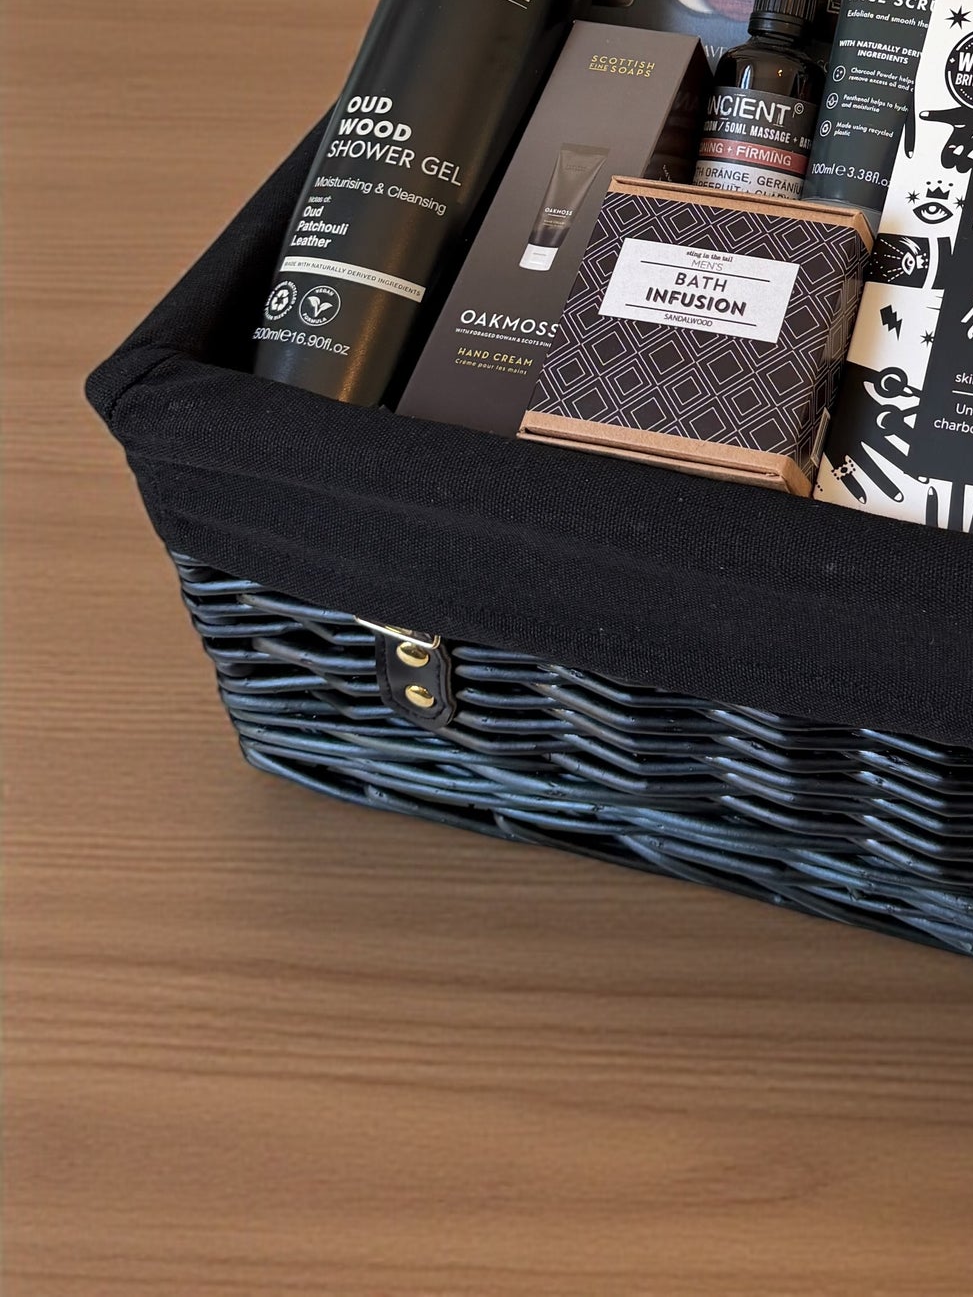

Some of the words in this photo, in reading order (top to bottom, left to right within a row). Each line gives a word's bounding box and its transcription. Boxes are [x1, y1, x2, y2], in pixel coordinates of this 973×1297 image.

[847, 10, 874, 19] Exfoliate
[875, 13, 890, 21] and
[890, 16, 917, 26] smooth
[856, 40, 900, 53] NATURALLY
[591, 55, 655, 70] SCOTTISH
[857, 49, 909, 65] INGREDIENTS
[589, 63, 609, 71] FINE
[610, 65, 651, 77] SOAPS
[851, 67, 876, 76] Charcoal
[876, 71, 898, 80] Powder
[899, 76, 914, 85] helps
[869, 78, 888, 86] excess
[346, 96, 393, 114] OUD
[843, 94, 870, 103] Panthenol
[870, 97, 886, 107] helps
[852, 104, 880, 113] moisturise
[338, 118, 412, 142] WOOD
[725, 122, 747, 135] 50ML
[750, 126, 791, 144] MASSAGE
[852, 124, 868, 133] using
[868, 127, 894, 138] recycled
[327, 140, 415, 169] SHOWER
[421, 157, 462, 187] GEL
[735, 145, 792, 166] FIRMING
[705, 167, 752, 185] ORANGE,
[811, 164, 835, 175] 100ml
[315, 176, 373, 194] Moisturising
[375, 183, 384, 194] &
[387, 186, 447, 216] Cleansing
[303, 206, 324, 217] Oud
[544, 207, 573, 216] OAKMOSS
[297, 220, 349, 236] Patchouli
[290, 235, 332, 248] Leather
[691, 259, 724, 271] MEN'S
[311, 263, 346, 274] NATURALLY
[346, 269, 377, 281] DERIVED
[377, 278, 421, 297] INGREDIENTS
[675, 272, 728, 292] BATH
[645, 287, 747, 317] INFUSION
[302, 312, 327, 324] FORMULA
[664, 313, 713, 327] SANDALWOOD
[457, 347, 489, 359] HAND
[493, 353, 534, 367] CREAM
